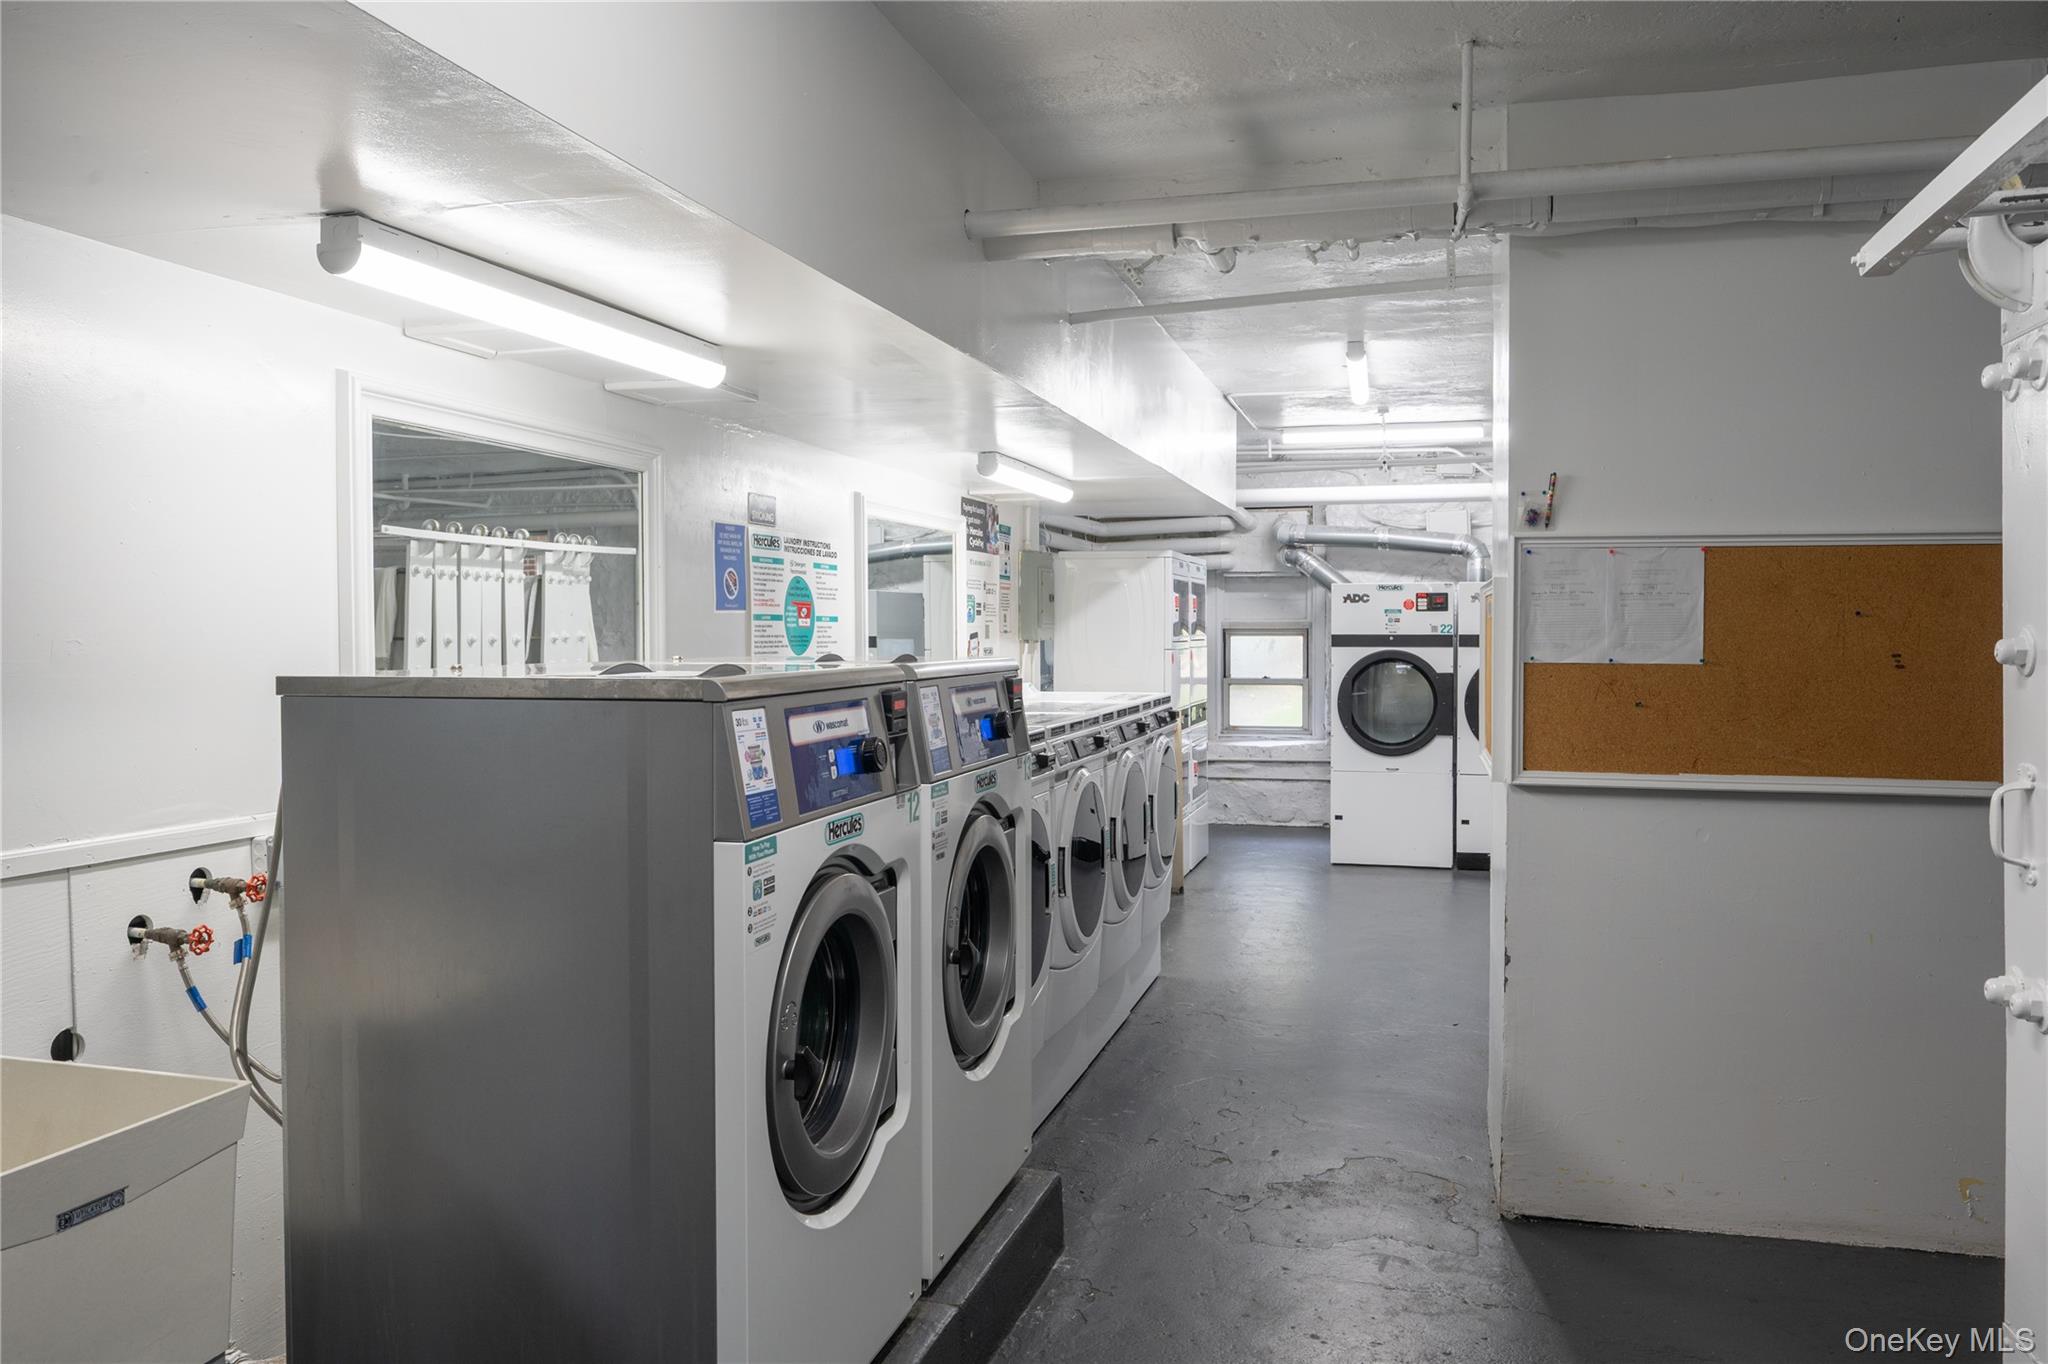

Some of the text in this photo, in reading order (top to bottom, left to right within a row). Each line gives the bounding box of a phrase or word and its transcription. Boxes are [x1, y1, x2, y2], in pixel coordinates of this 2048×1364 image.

[753, 533, 780, 549] Hercules
[784, 536, 831, 550] LAUNDRY INSTRUCTIONS
[784, 545, 838, 559] INSTRUCCIONES DE LAVADO
[1344, 594, 1370, 604] ADC
[1440, 624, 1453, 633] 22
[826, 718, 848, 730] wascomat
[907, 791, 920, 823] 12
[827, 816, 863, 841] Hercules
